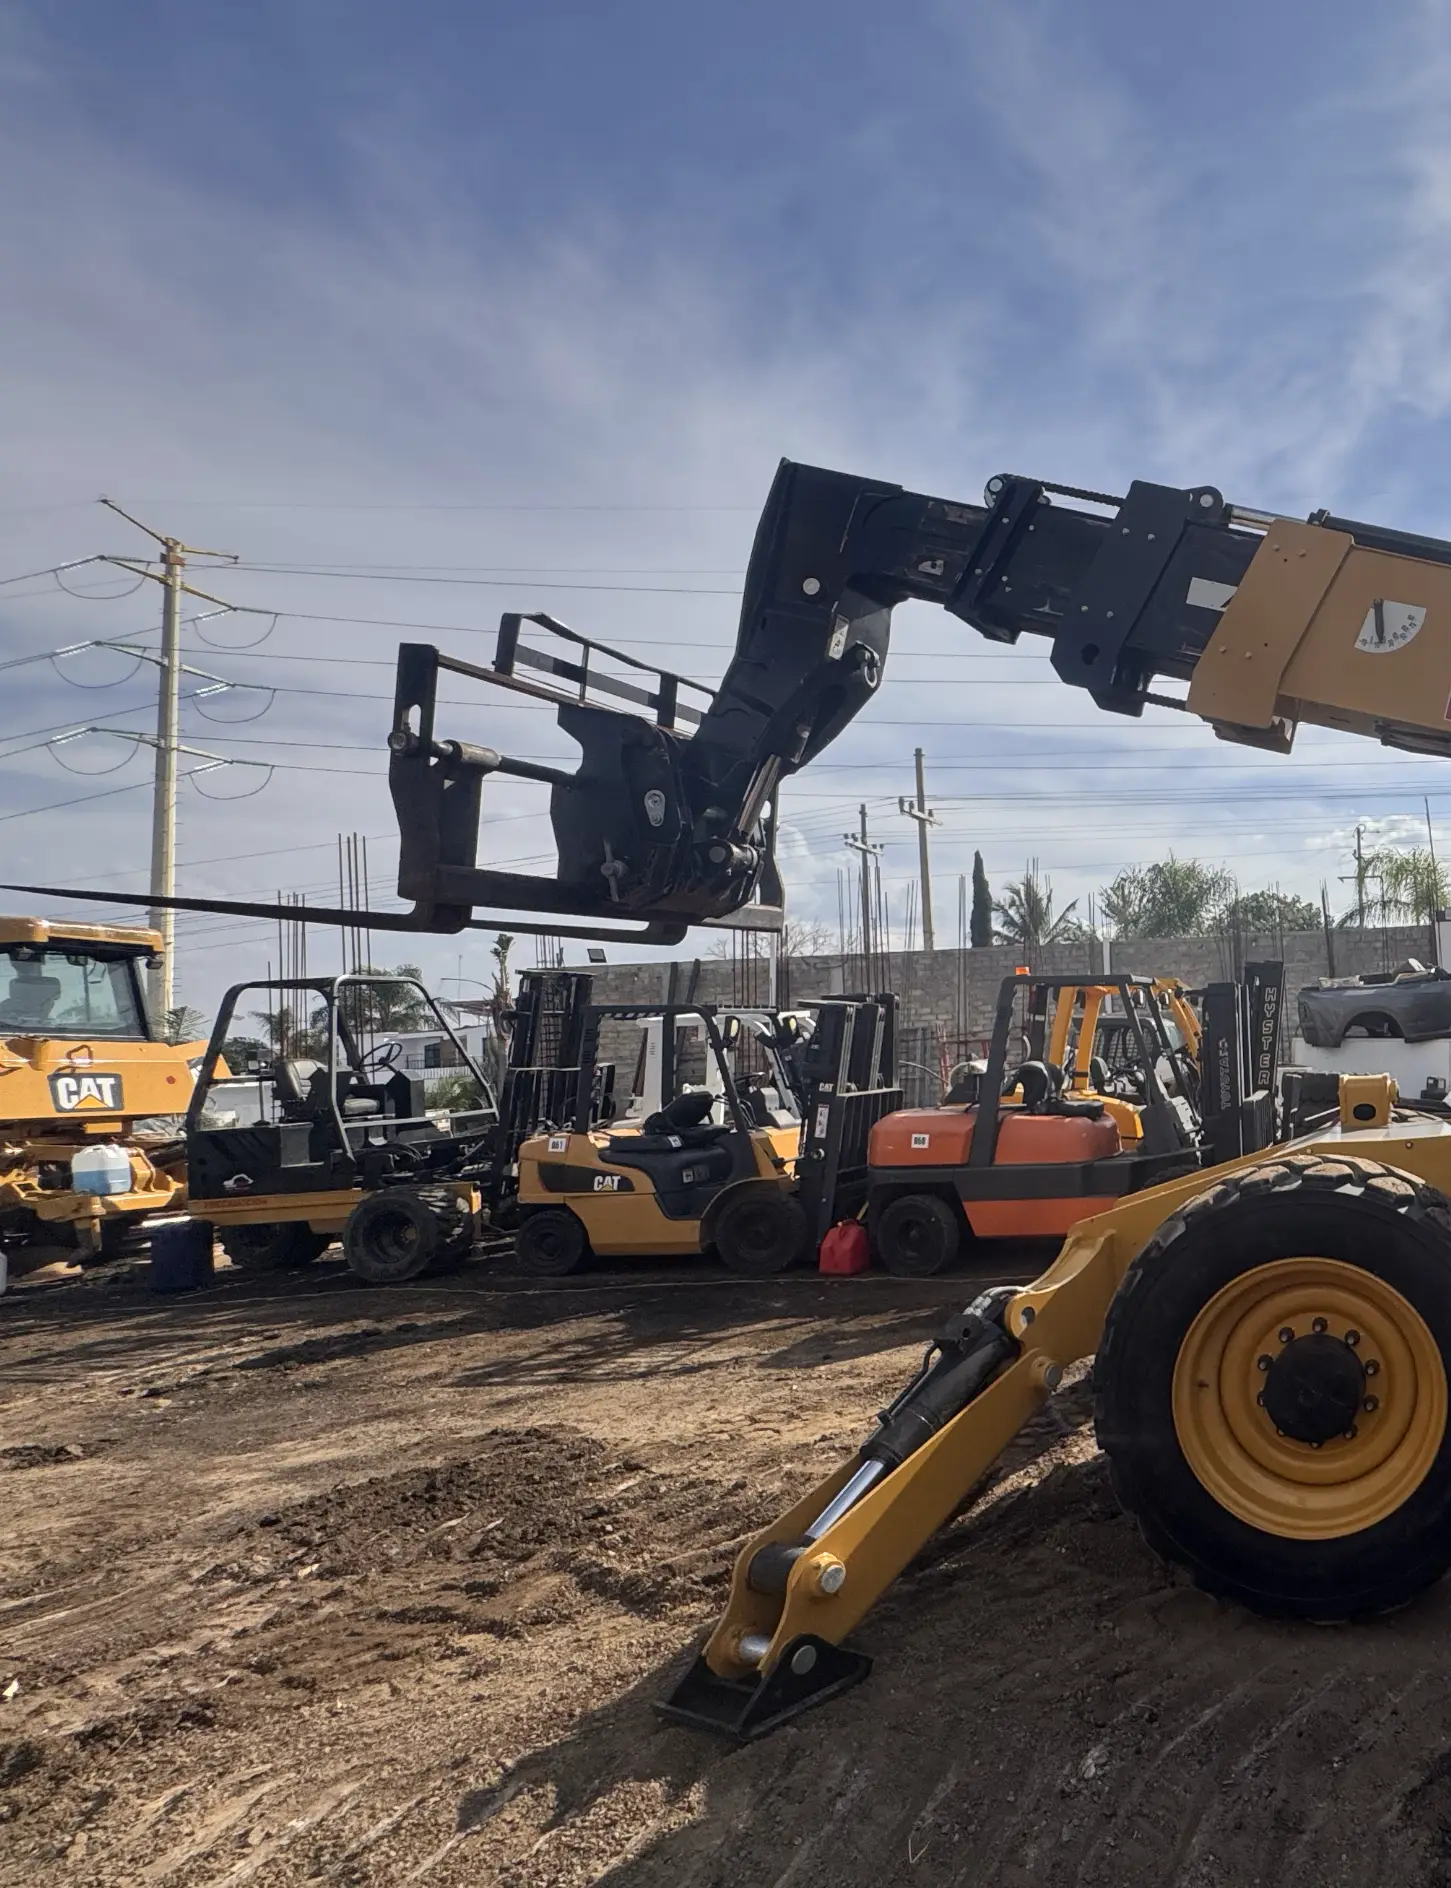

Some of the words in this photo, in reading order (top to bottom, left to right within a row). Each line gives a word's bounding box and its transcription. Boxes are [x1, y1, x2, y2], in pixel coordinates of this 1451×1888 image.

[1258, 987, 1277, 1085] HYSTER
[56, 1077, 117, 1110] CAT
[818, 1082, 834, 1093] CAT
[593, 1175, 621, 1192] CAT
